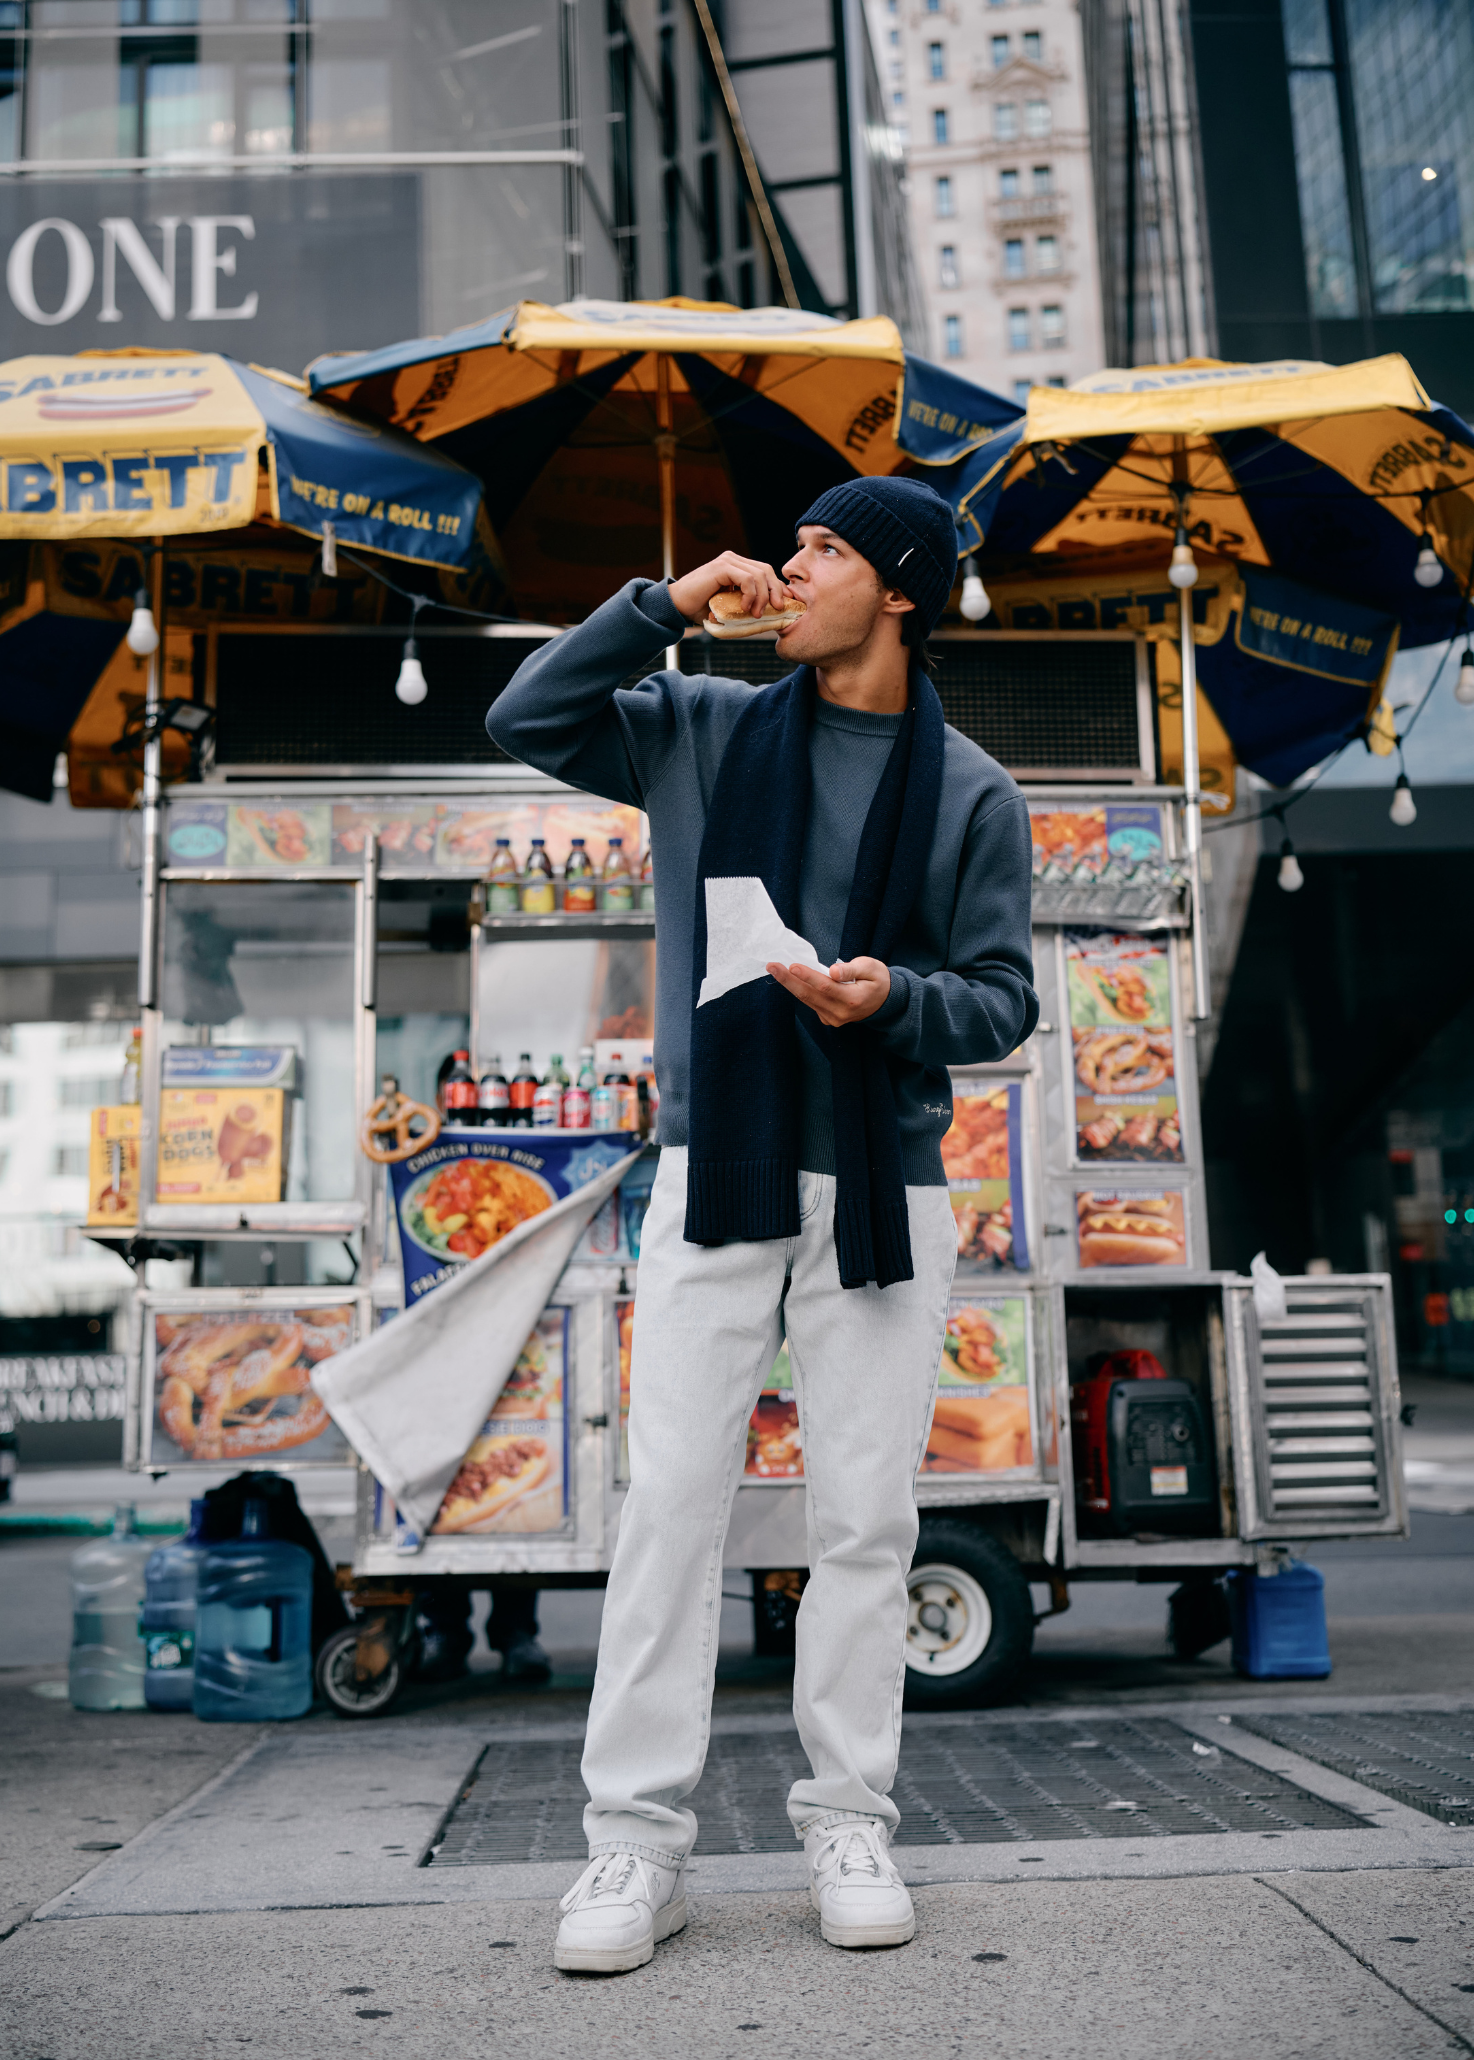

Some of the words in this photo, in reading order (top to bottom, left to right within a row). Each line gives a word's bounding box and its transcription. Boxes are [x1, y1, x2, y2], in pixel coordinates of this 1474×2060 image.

[6, 214, 259, 326] ONE
[0, 446, 248, 514] BRETT
[290, 474, 340, 509] WE'RE
[343, 493, 371, 515] ON
[370, 501, 385, 519] A
[388, 503, 433, 530] ROLL
[436, 513, 461, 535] !!!
[1280, 616, 1301, 636] ON
[1300, 622, 1313, 639] A
[1312, 625, 1348, 650] ROLL
[161, 1129, 213, 1145] CORN
[163, 1145, 215, 1162] DOGS
[406, 1142, 469, 1174] CHICKEN
[471, 1142, 509, 1159] OVER
